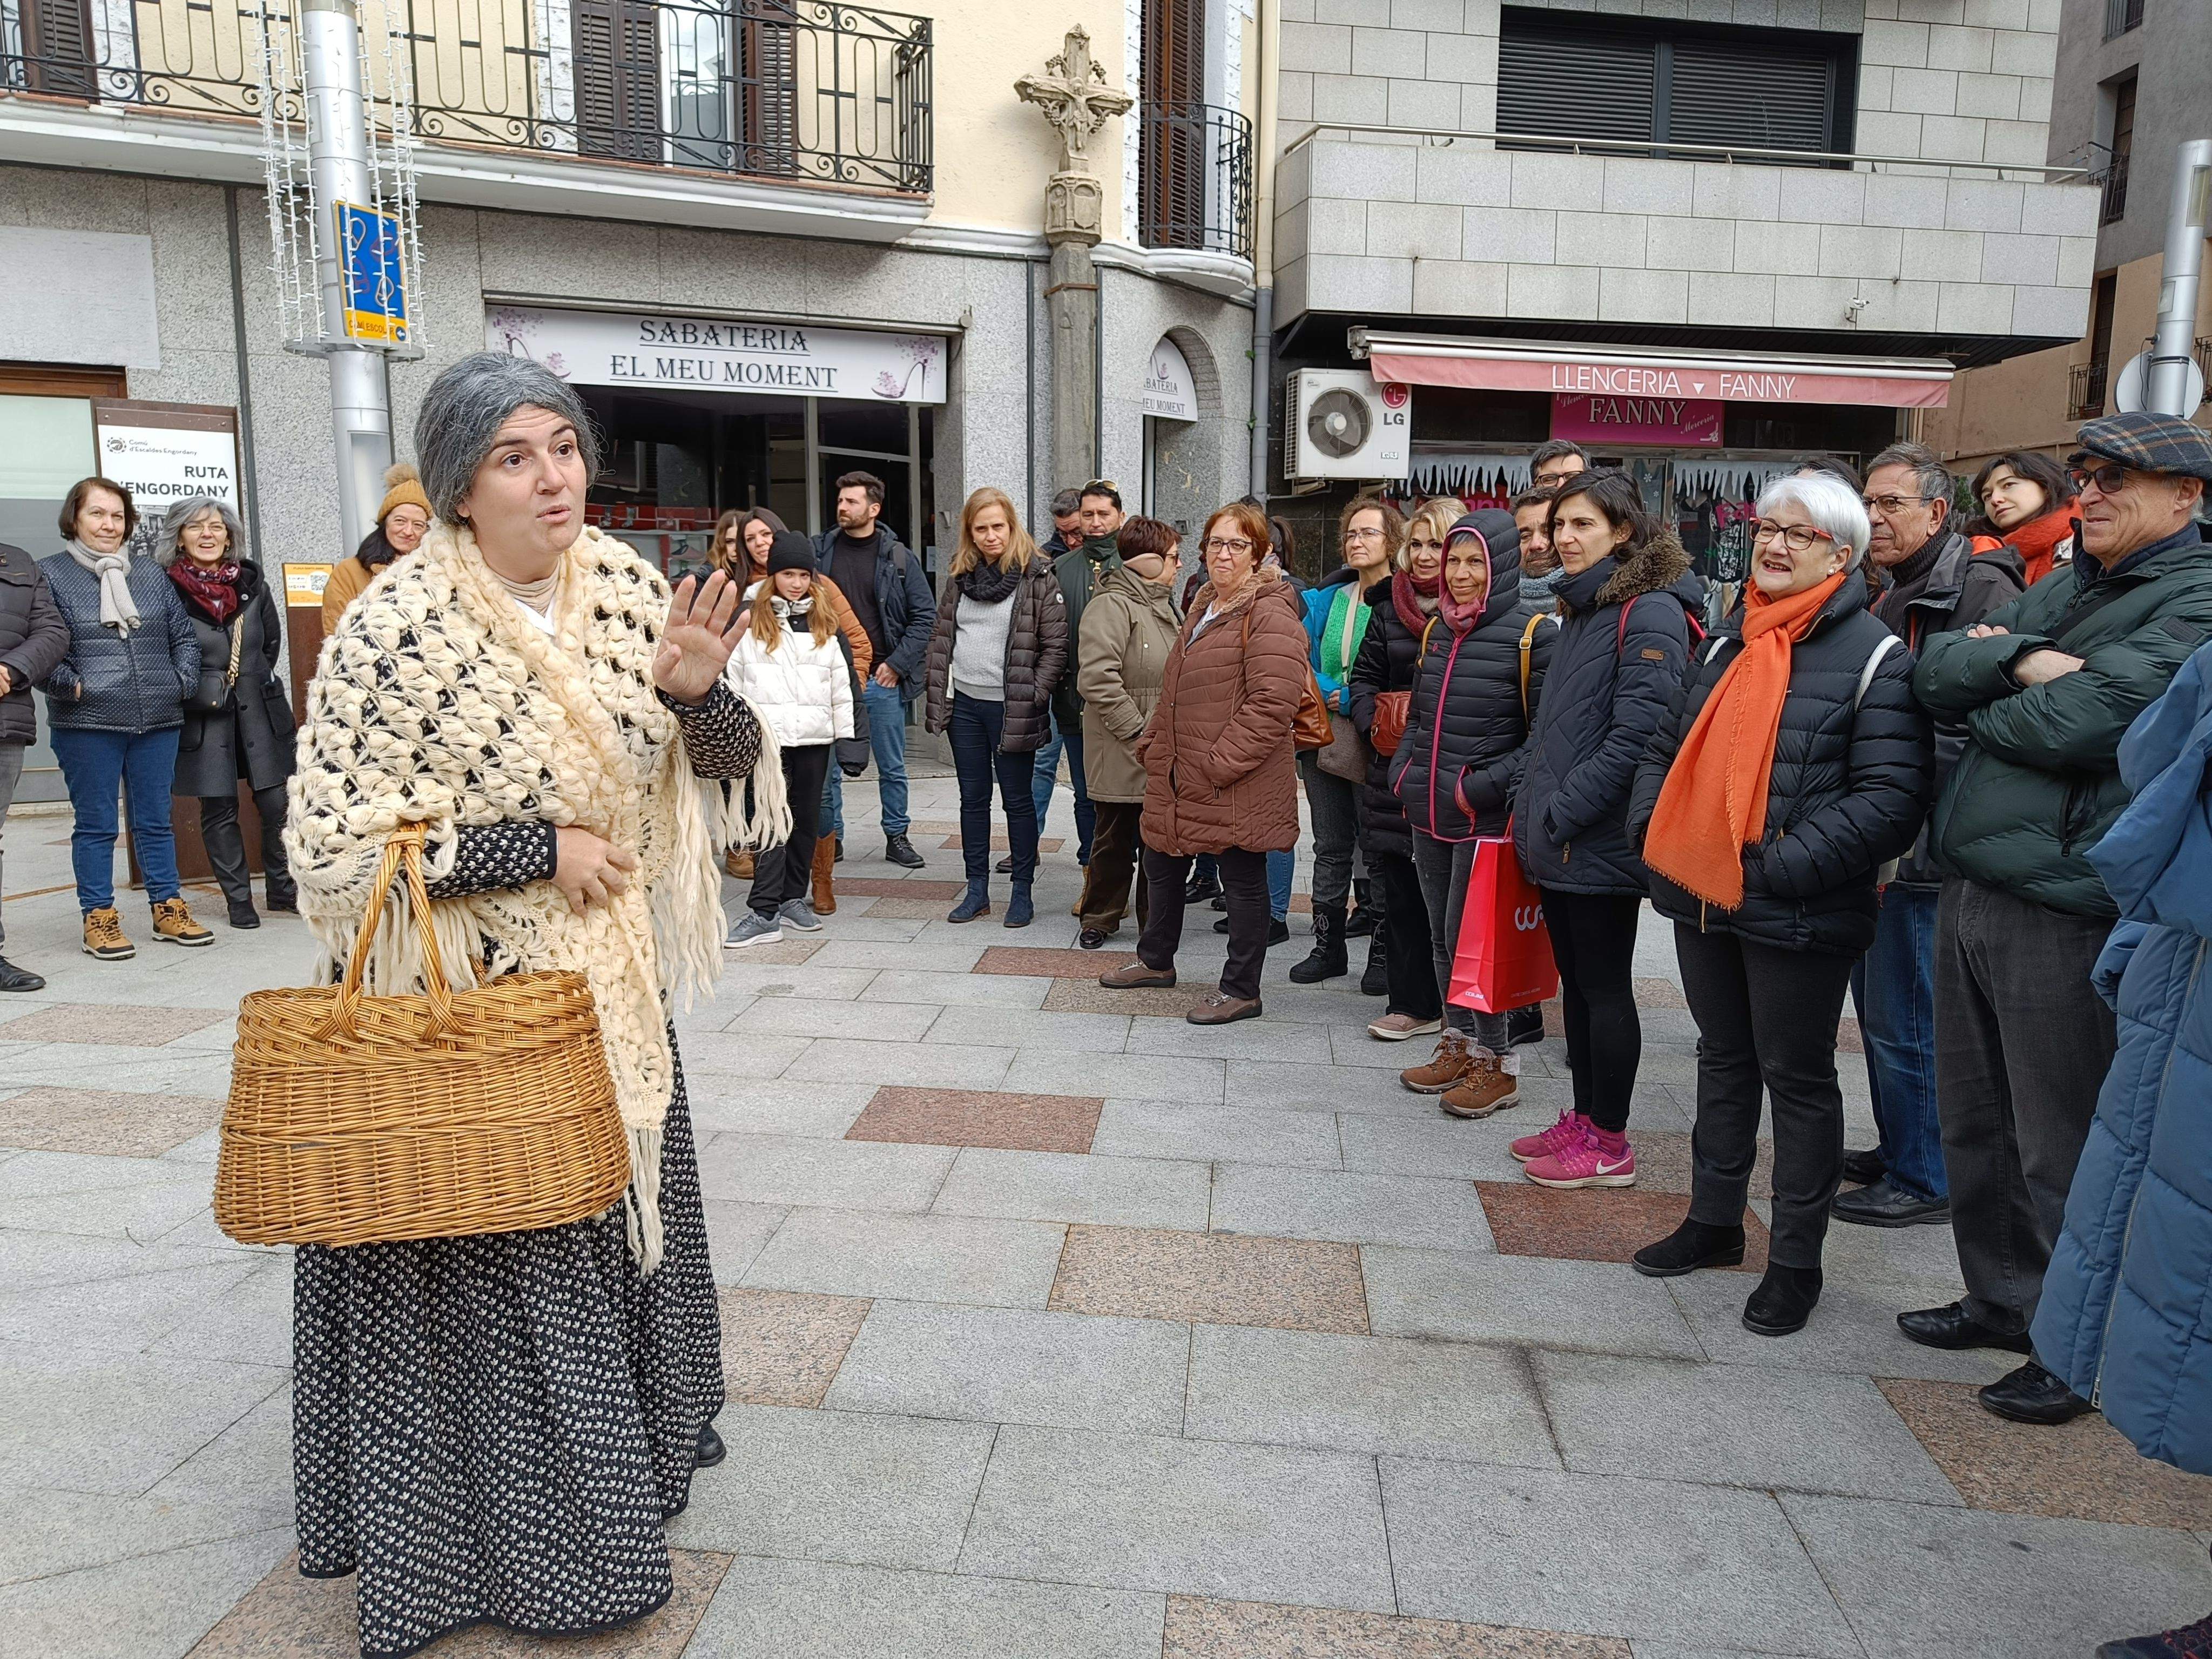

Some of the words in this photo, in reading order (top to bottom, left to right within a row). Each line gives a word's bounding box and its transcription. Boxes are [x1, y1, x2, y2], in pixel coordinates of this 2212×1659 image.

[366, 322, 394, 335] ESCOLR
[639, 320, 810, 352] SABATERIA
[610, 355, 646, 377] EL
[655, 357, 714, 381] MEU
[724, 361, 838, 388] MOMENT
[1143, 377, 1178, 393] BATERIA
[1552, 365, 1682, 395] LLENCERIA
[1719, 373, 1797, 399] FANNY
[1156, 400, 1185, 414] MOMENT
[1589, 398, 1687, 425] FANNY
[1384, 413, 1404, 426] LG
[185, 466, 228, 479] RUTA
[120, 481, 228, 497] 'ENGORDANY
